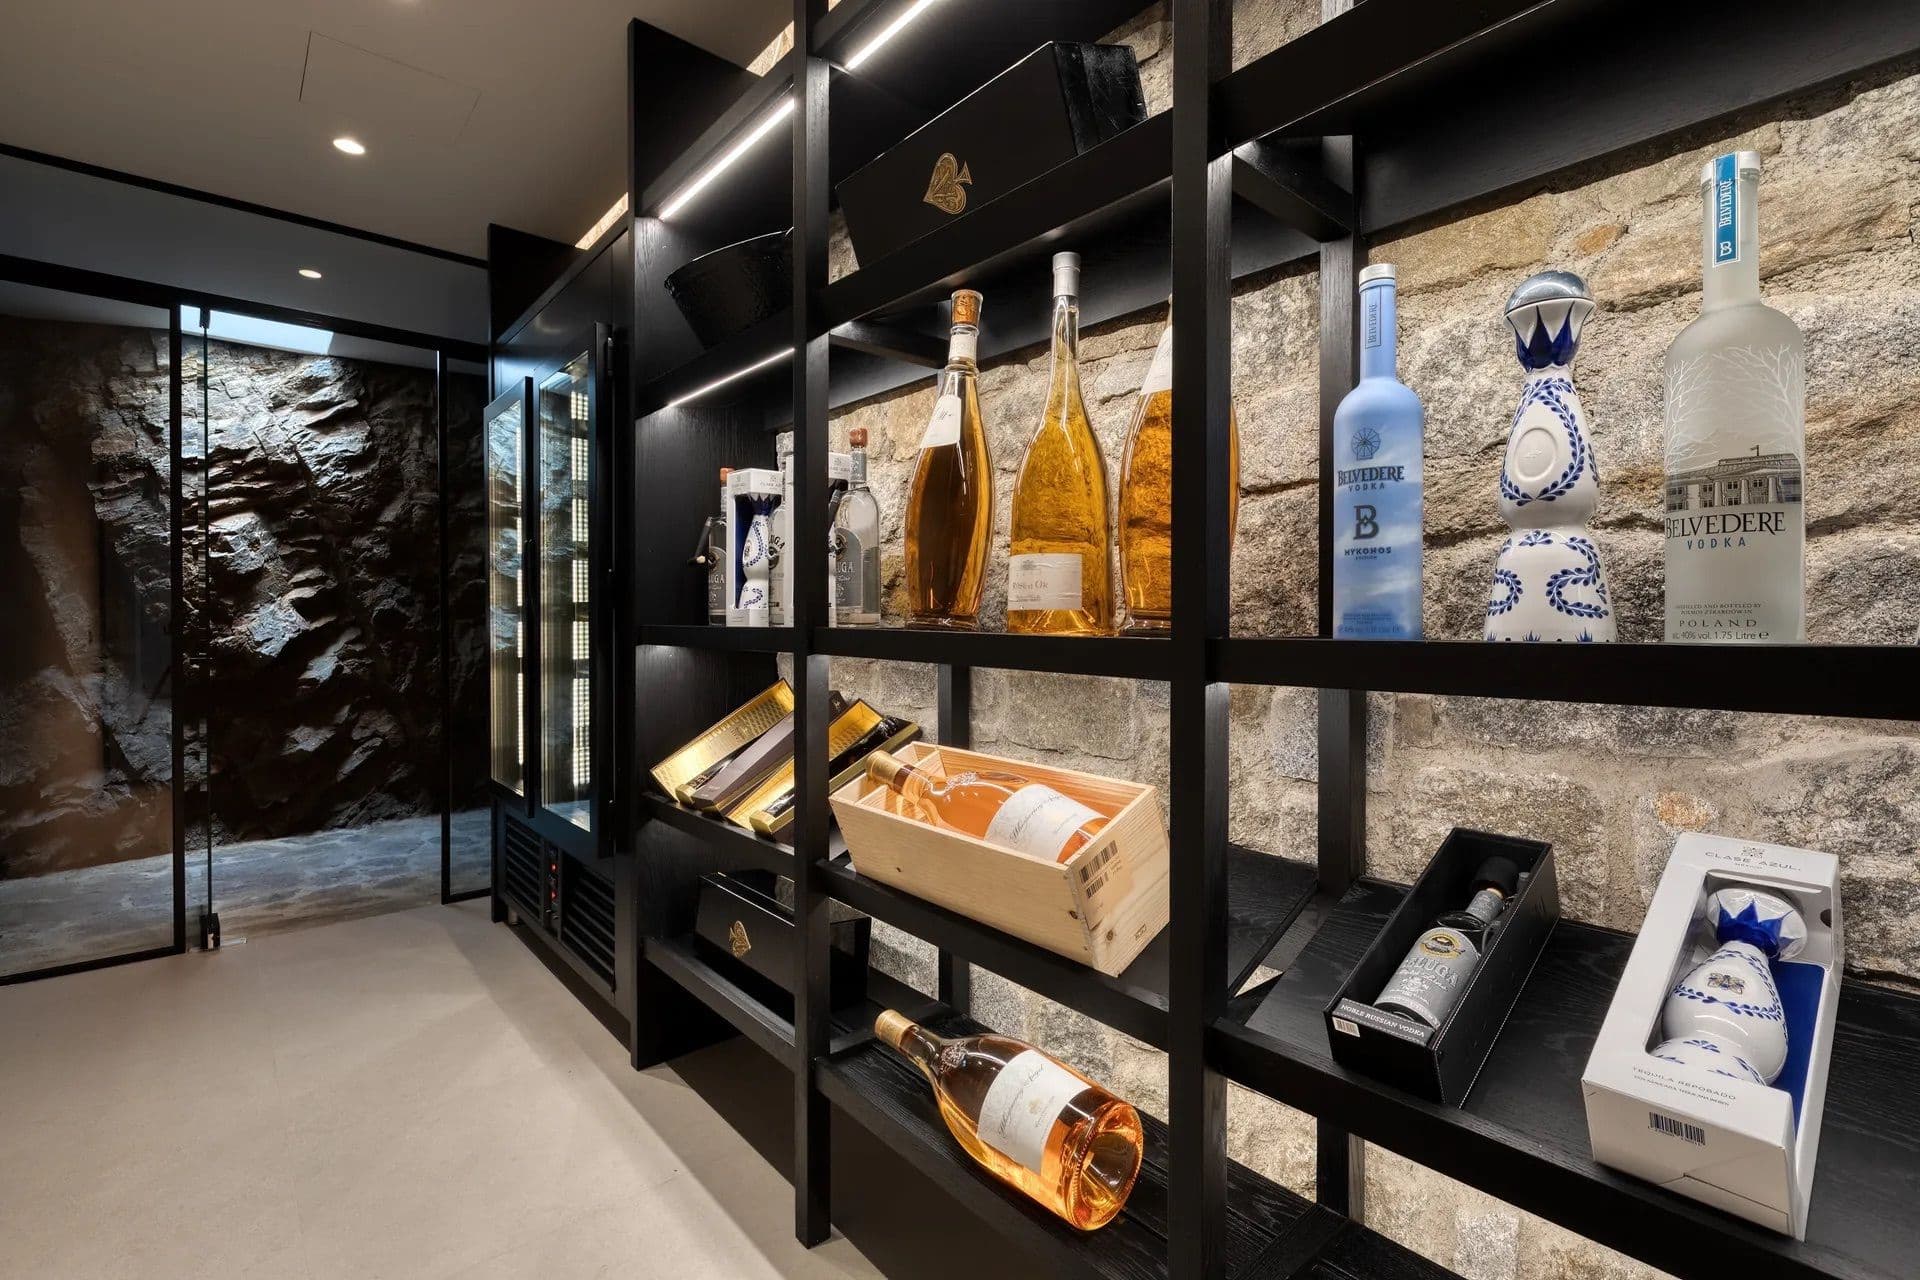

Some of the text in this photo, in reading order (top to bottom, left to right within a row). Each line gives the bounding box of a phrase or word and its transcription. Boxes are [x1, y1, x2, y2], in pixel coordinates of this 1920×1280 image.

[1720, 241, 1732, 256] B
[1337, 466, 1405, 487] BELVEDERE
[1349, 482, 1385, 492] VODKA
[1353, 505, 1379, 540] B
[1665, 511, 1786, 539] BELVEDERE
[1687, 537, 1746, 550] VODKA
[1680, 619, 1757, 628] POLAND
[1715, 631, 1733, 640] 1.75
[1736, 631, 1756, 640] Litre
[1704, 851, 1752, 863] CLASE
[1365, 1013, 1398, 1028] RUSSIAN
[1399, 1024, 1425, 1038] VODKA
